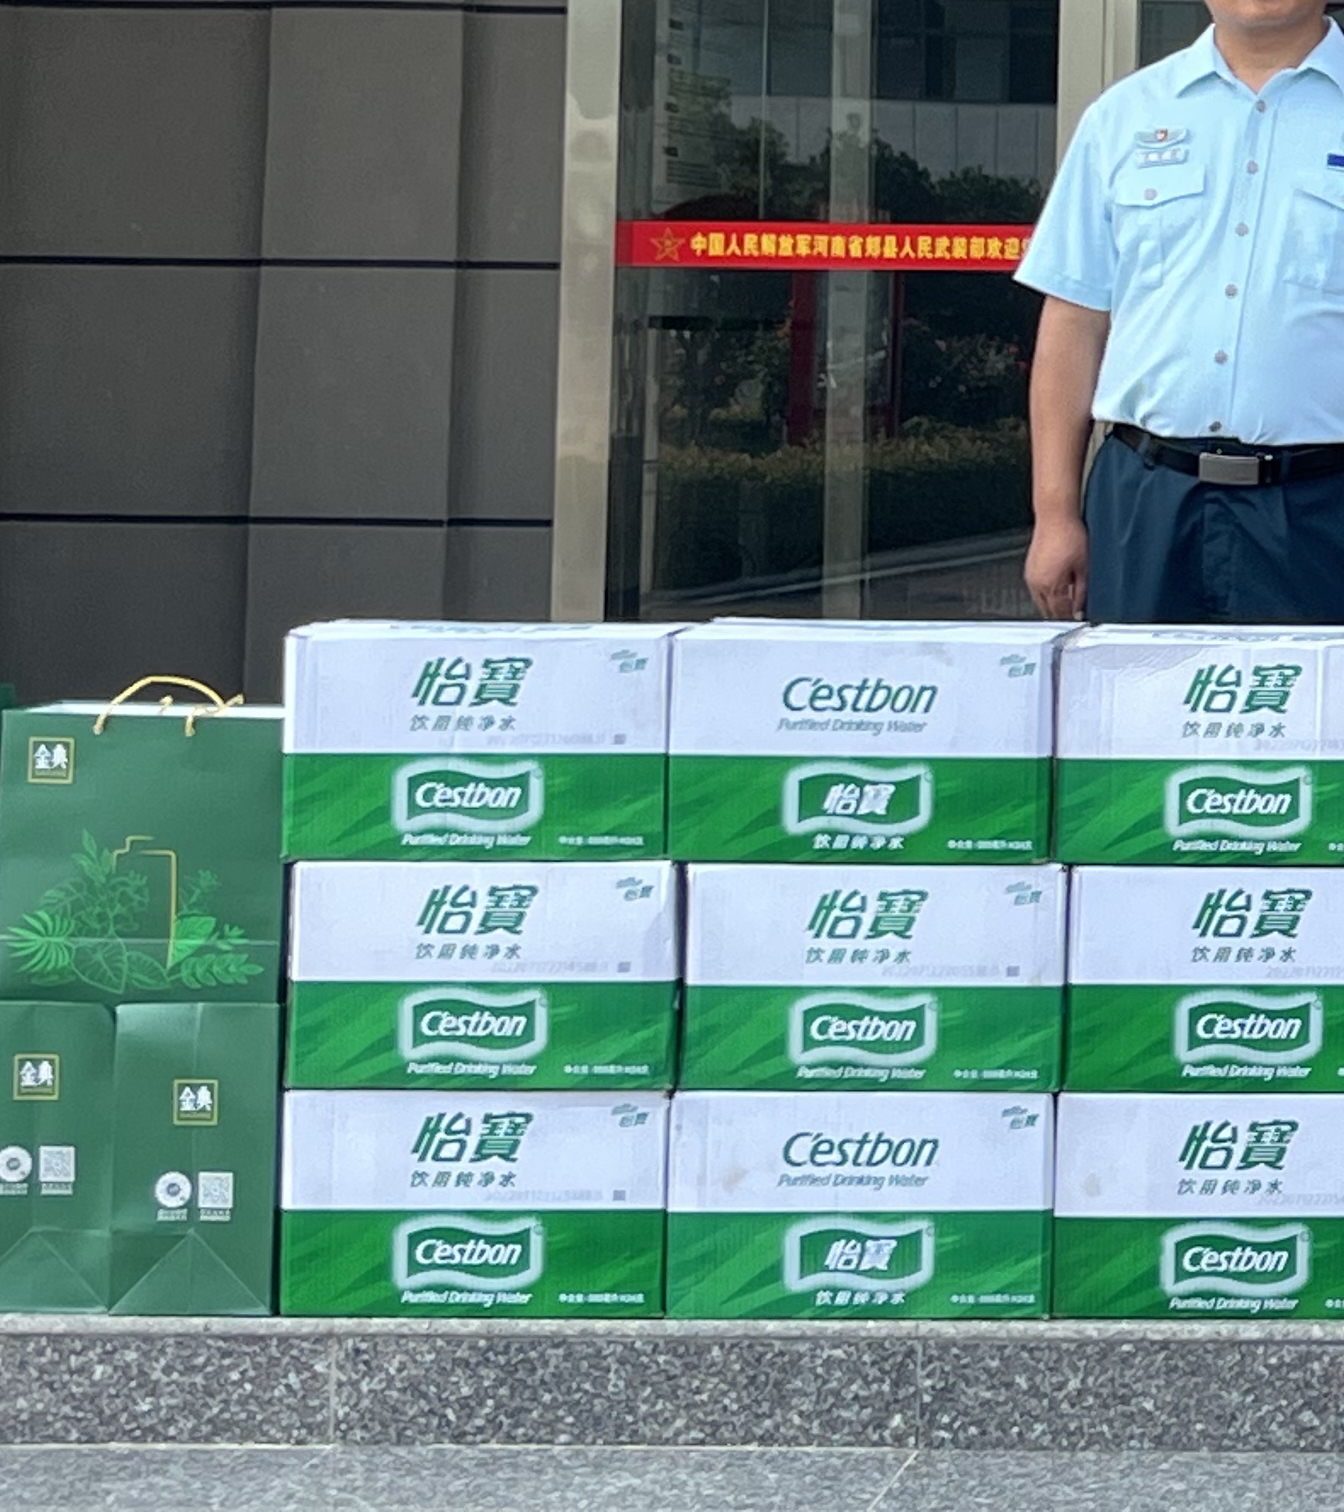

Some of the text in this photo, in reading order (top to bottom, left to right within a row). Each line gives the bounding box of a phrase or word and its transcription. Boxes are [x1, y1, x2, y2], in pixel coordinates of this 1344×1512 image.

[690, 232, 1031, 259] 中国人民解放军河南省郏县人民武装部欢迎
[412, 657, 532, 706] 怡寶
[1184, 665, 1302, 713] 怡寶
[418, 885, 538, 934] 怡寶
[807, 890, 927, 939] 怡寶
[1194, 889, 1312, 937] 怡寶
[411, 1112, 534, 1162] 怡寶
[1179, 1120, 1299, 1169] 怡寶
